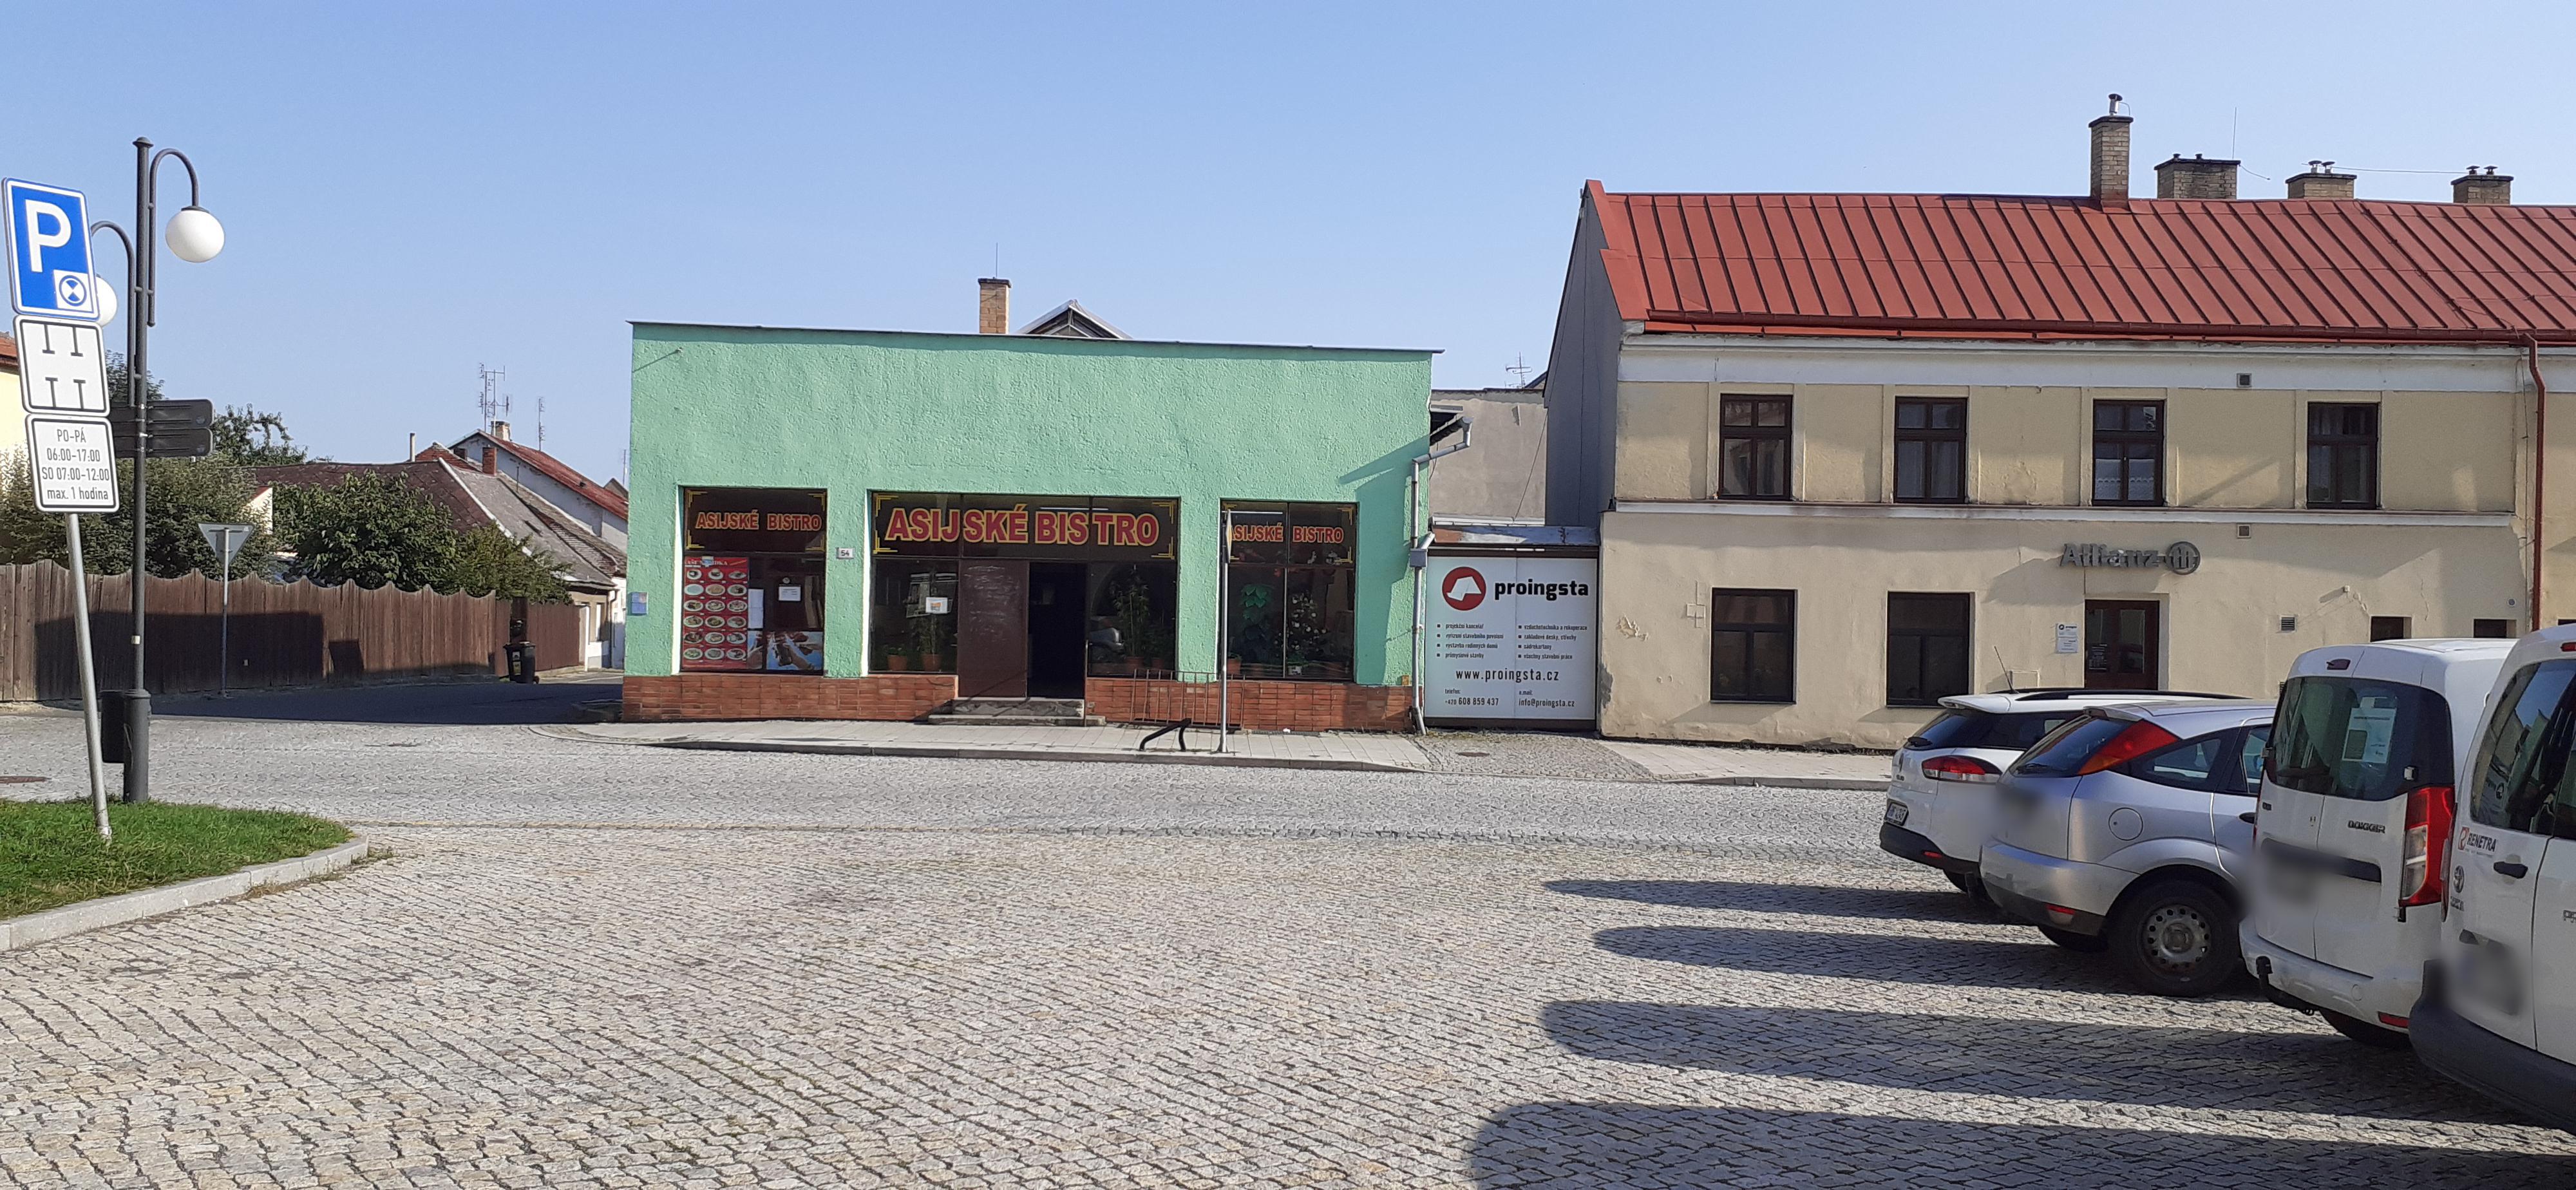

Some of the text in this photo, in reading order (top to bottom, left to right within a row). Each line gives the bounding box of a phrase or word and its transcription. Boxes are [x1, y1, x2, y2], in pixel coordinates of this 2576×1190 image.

[25, 199, 71, 272] P
[57, 427, 86, 443] PO-PÁ
[46, 448, 100, 462] 06:00-17:00
[42, 467, 109, 481] SO 07:00-12:00
[47, 486, 108, 500] max. 1 hodina
[696, 510, 822, 531] ASIJSKÉ BISTRO
[885, 504, 1159, 547] ASIJSKÉ BISTRO
[1231, 522, 1344, 543] SIJSKÉ BISTRO
[2061, 543, 2159, 567] Allianz
[1495, 579, 1589, 601] proingsta
[1455, 668, 1559, 683] www.proingsta.cz
[1486, 697, 1499, 706] 437
[1519, 698, 1575, 708] info@proingsta.cz
